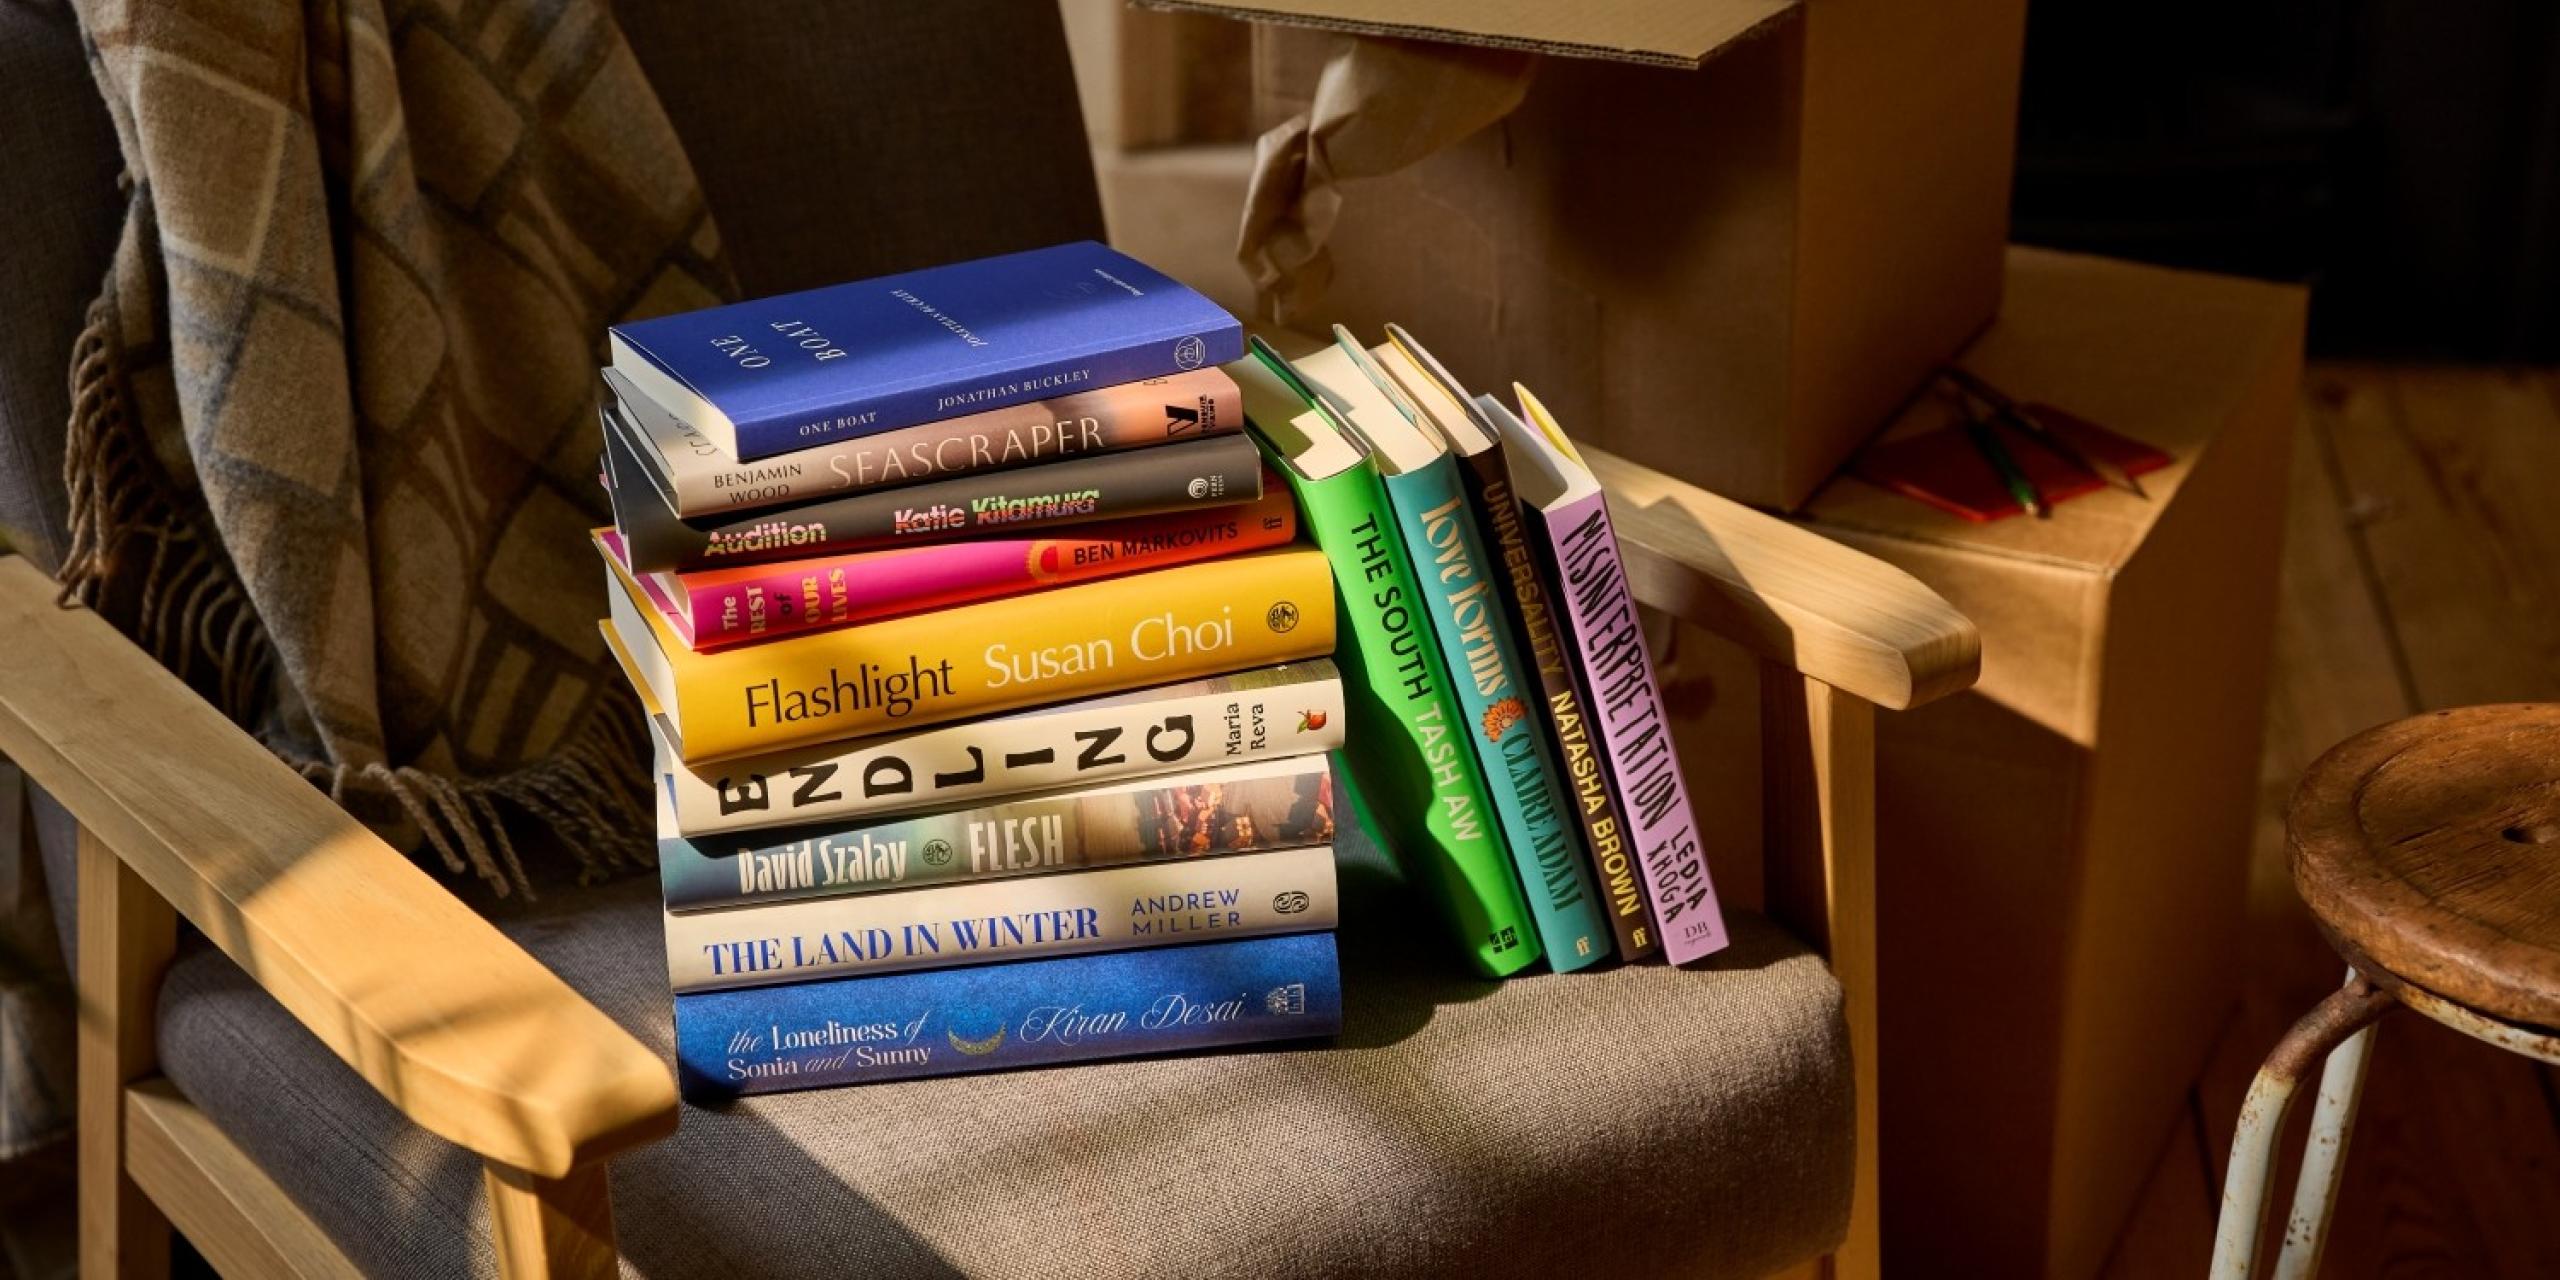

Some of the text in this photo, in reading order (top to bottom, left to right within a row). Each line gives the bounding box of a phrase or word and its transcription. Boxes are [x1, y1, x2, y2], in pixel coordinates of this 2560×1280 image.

[711, 335, 771, 369] ONE
[770, 320, 848, 361] BOAT
[937, 368, 1091, 412] JONATHAN BUCKLEY
[799, 410, 877, 437] ONE BOAT
[714, 463, 802, 489] BENJAMIN
[830, 416, 1105, 490] SEASCRAPER
[730, 483, 790, 505] WOOD
[894, 488, 1101, 535] Katie Kitamura
[704, 521, 827, 557] Audition
[1073, 521, 1239, 566] BEN MARKOVITS
[773, 591, 793, 615] of
[801, 576, 821, 624] OUR
[828, 567, 848, 622] LIVES
[1351, 512, 1434, 701] THE SOUTH
[1420, 495, 1510, 697] love forms
[1484, 480, 1565, 683] UNIVERSALITY
[721, 596, 738, 631] The
[984, 605, 1233, 689] Susan Choi
[1561, 507, 1682, 833] MISINTERPRETATION
[745, 655, 957, 728] Flashlight
[1225, 701, 1241, 757] Maria
[1250, 702, 1266, 751] Reva
[718, 714, 1195, 818] ENDLING
[1415, 701, 1483, 841] TASH AW
[1501, 732, 1584, 912] CLAIRE ADAM
[1550, 690, 1641, 918] NATASHA BROWN
[737, 833, 908, 895] David Szalay
[968, 814, 1065, 873] FLESH
[1669, 824, 1709, 912] LEDIA
[1131, 888, 1241, 917] ANDREW
[1646, 838, 1686, 926] XHOGA
[703, 907, 1101, 976] THE LAND IN WINTER
[1132, 911, 1242, 937] MILLER
[728, 1007, 933, 1055] the Loneliness of
[1020, 1002, 1129, 1047] Kiran
[1140, 991, 1248, 1031] Desai
[727, 1045, 931, 1081] Sonia and Sunny
